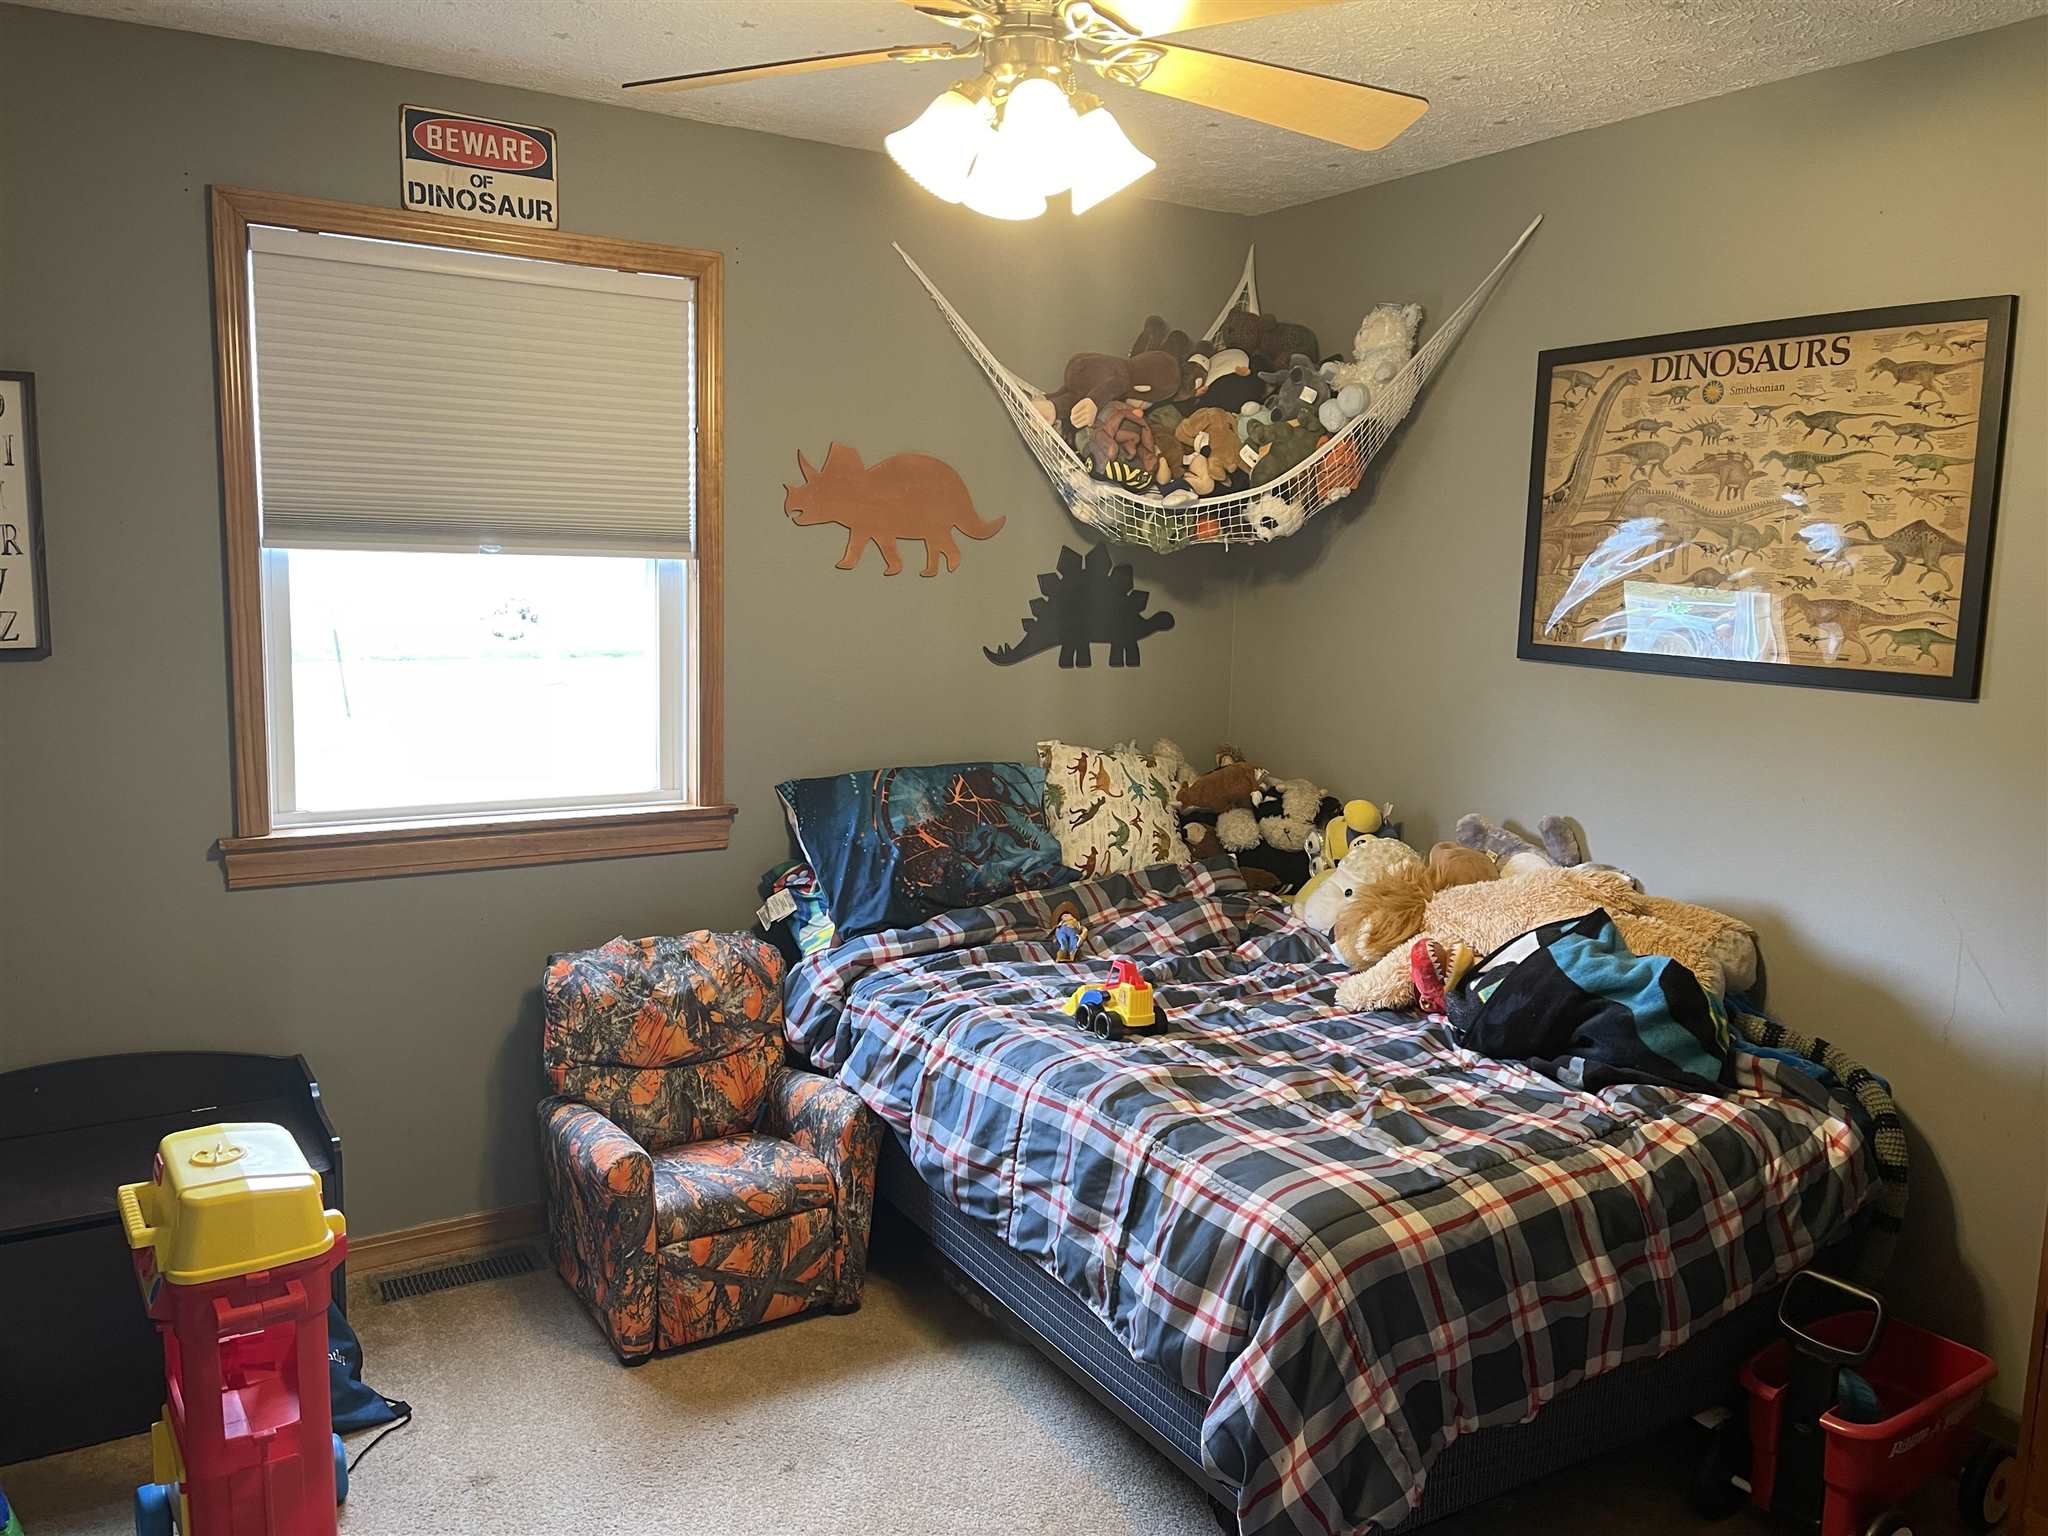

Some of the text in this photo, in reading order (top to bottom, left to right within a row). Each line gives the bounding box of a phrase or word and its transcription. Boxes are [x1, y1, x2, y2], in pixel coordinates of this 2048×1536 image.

[426, 124, 534, 165] BEWARE
[470, 174, 494, 189] OF
[408, 181, 553, 222] DINOSAUR
[1650, 336, 1851, 383] DINOSAURS
[1729, 383, 1786, 396] Smithsonian
[0, 524, 24, 555] R
[0, 611, 20, 641] Z
